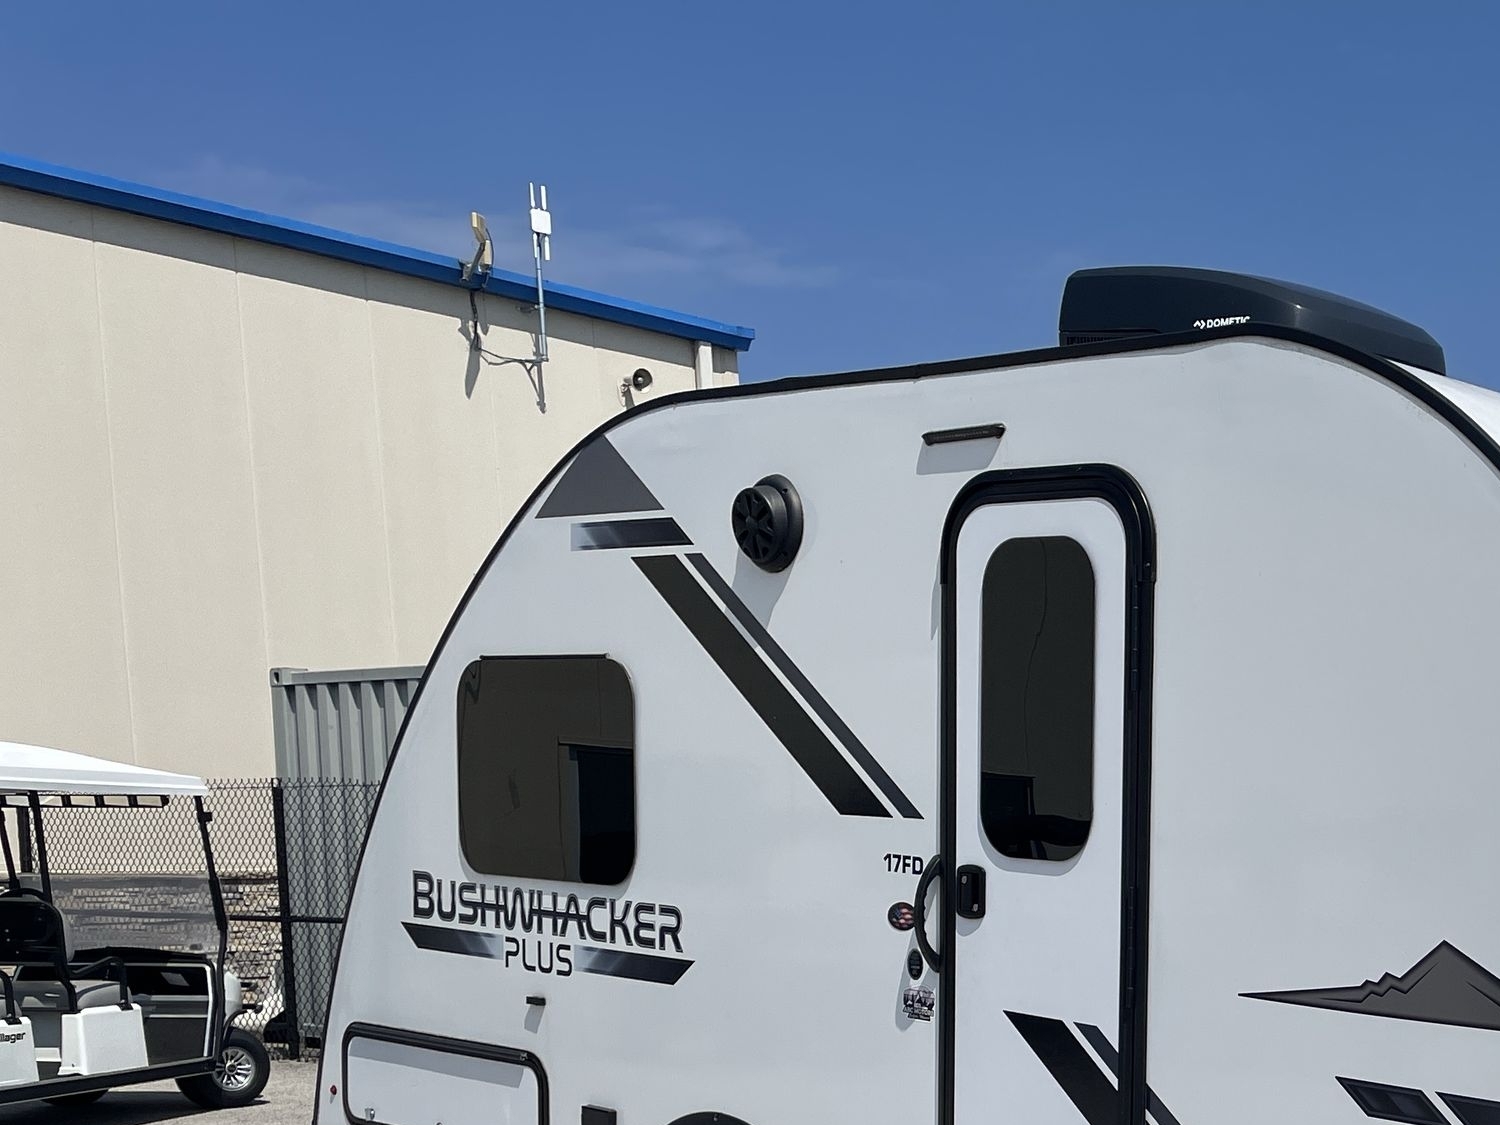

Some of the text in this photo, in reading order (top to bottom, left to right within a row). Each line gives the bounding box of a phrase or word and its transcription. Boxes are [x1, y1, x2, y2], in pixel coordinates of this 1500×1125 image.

[883, 853, 924, 876] 17FD
[412, 869, 684, 953] BUSHWHACKER
[504, 936, 573, 977] PLUS
